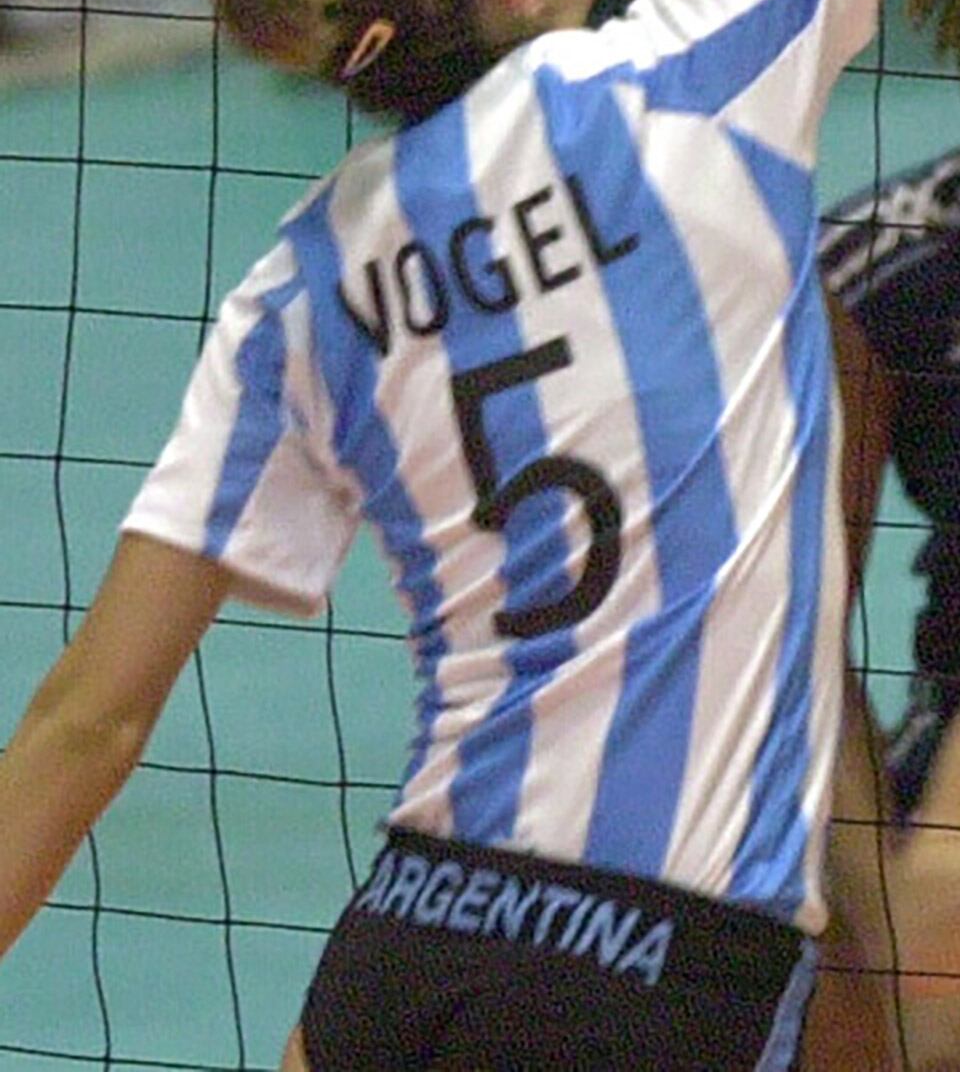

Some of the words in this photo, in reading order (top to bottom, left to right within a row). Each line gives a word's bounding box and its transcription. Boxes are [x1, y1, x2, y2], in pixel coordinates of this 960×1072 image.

[336, 173, 640, 358] VOGEL
[451, 335, 622, 639] 5
[355, 851, 675, 986] ARGENTINA
